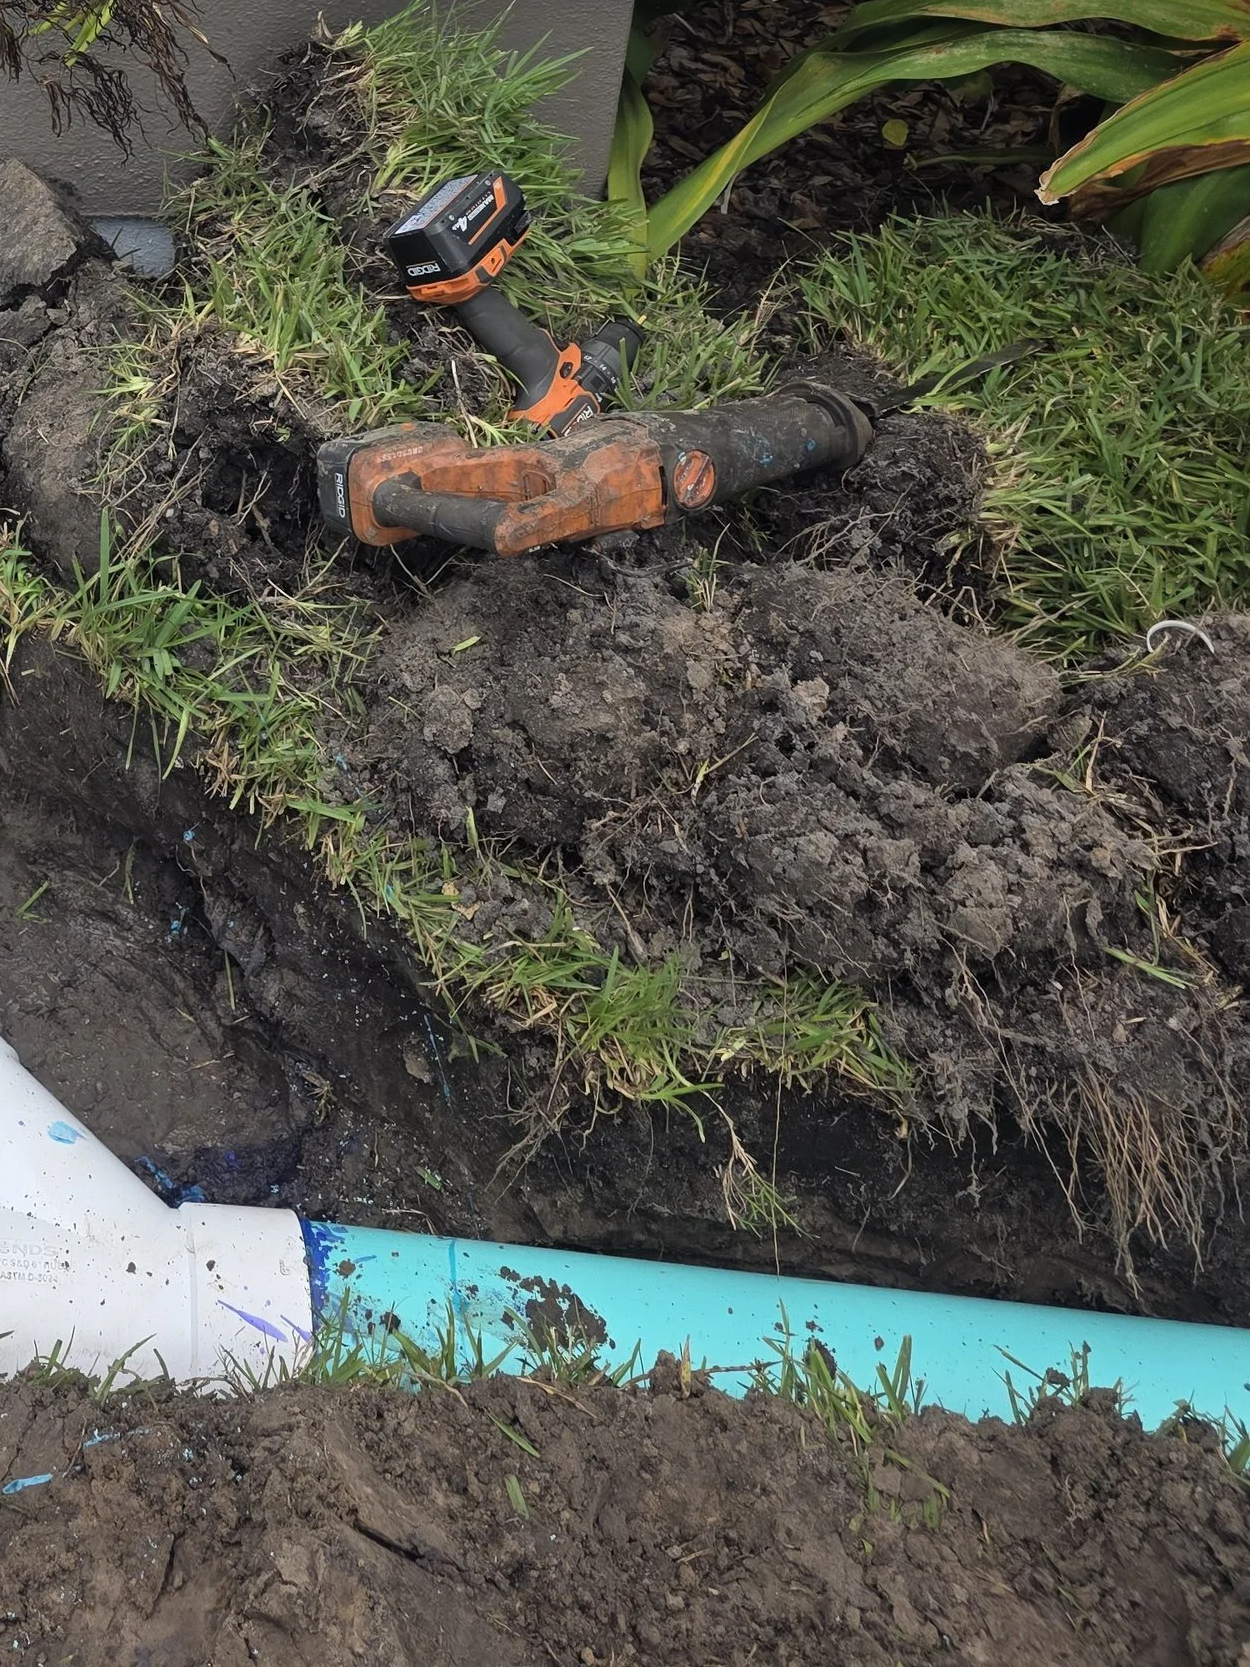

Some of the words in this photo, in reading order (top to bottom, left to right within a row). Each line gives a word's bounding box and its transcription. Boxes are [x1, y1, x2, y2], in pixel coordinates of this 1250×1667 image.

[407, 262, 441, 277] RIDGID
[564, 405, 594, 437] RID
[334, 472, 346, 518] RIDGID
